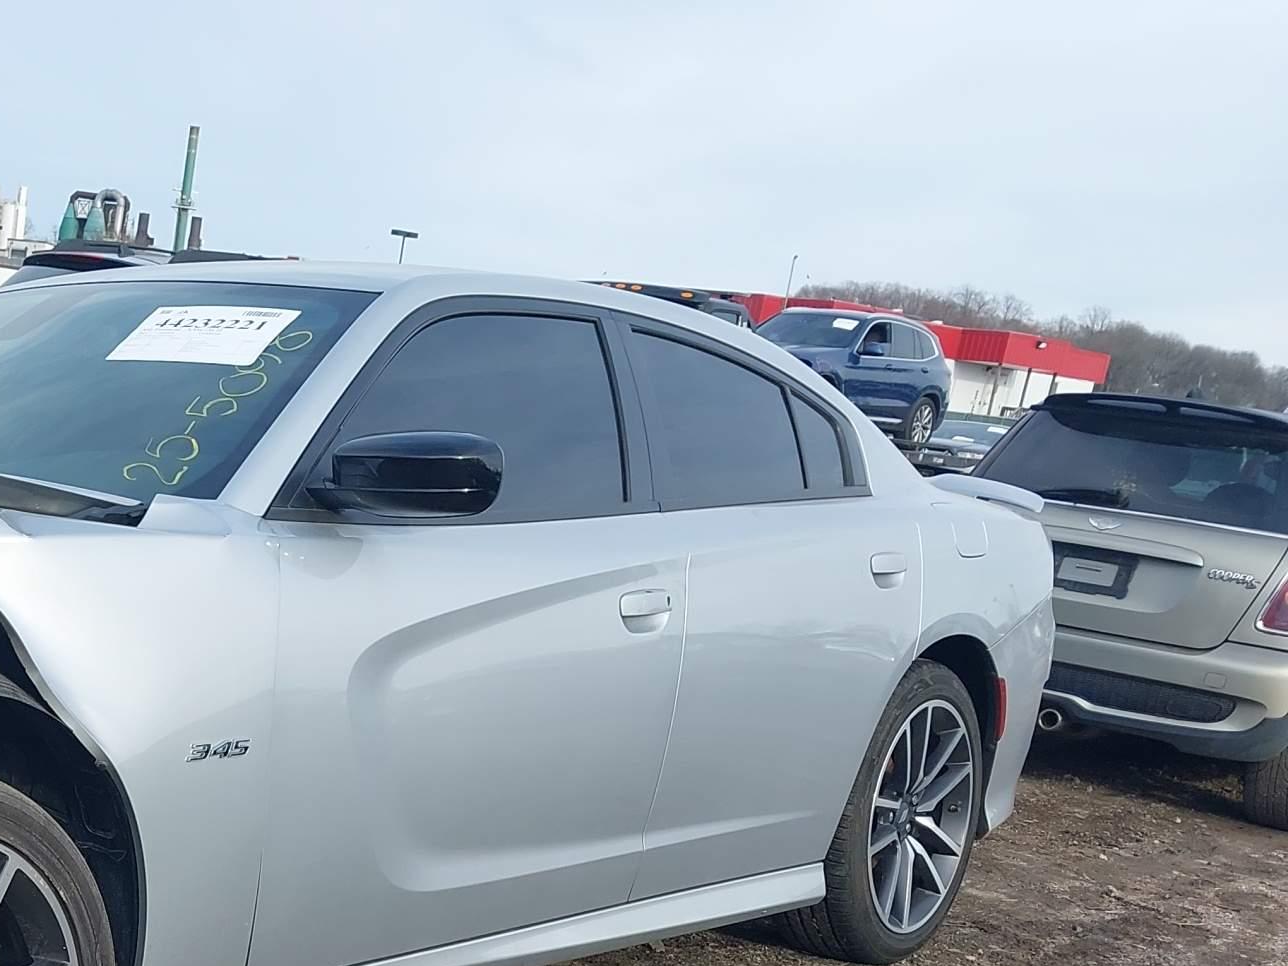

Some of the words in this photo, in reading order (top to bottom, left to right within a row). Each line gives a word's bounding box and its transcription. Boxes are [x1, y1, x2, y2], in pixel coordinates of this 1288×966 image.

[155, 317, 268, 331] 44232221
[1207, 568, 1254, 584] COOPER
[185, 738, 252, 763] 345
